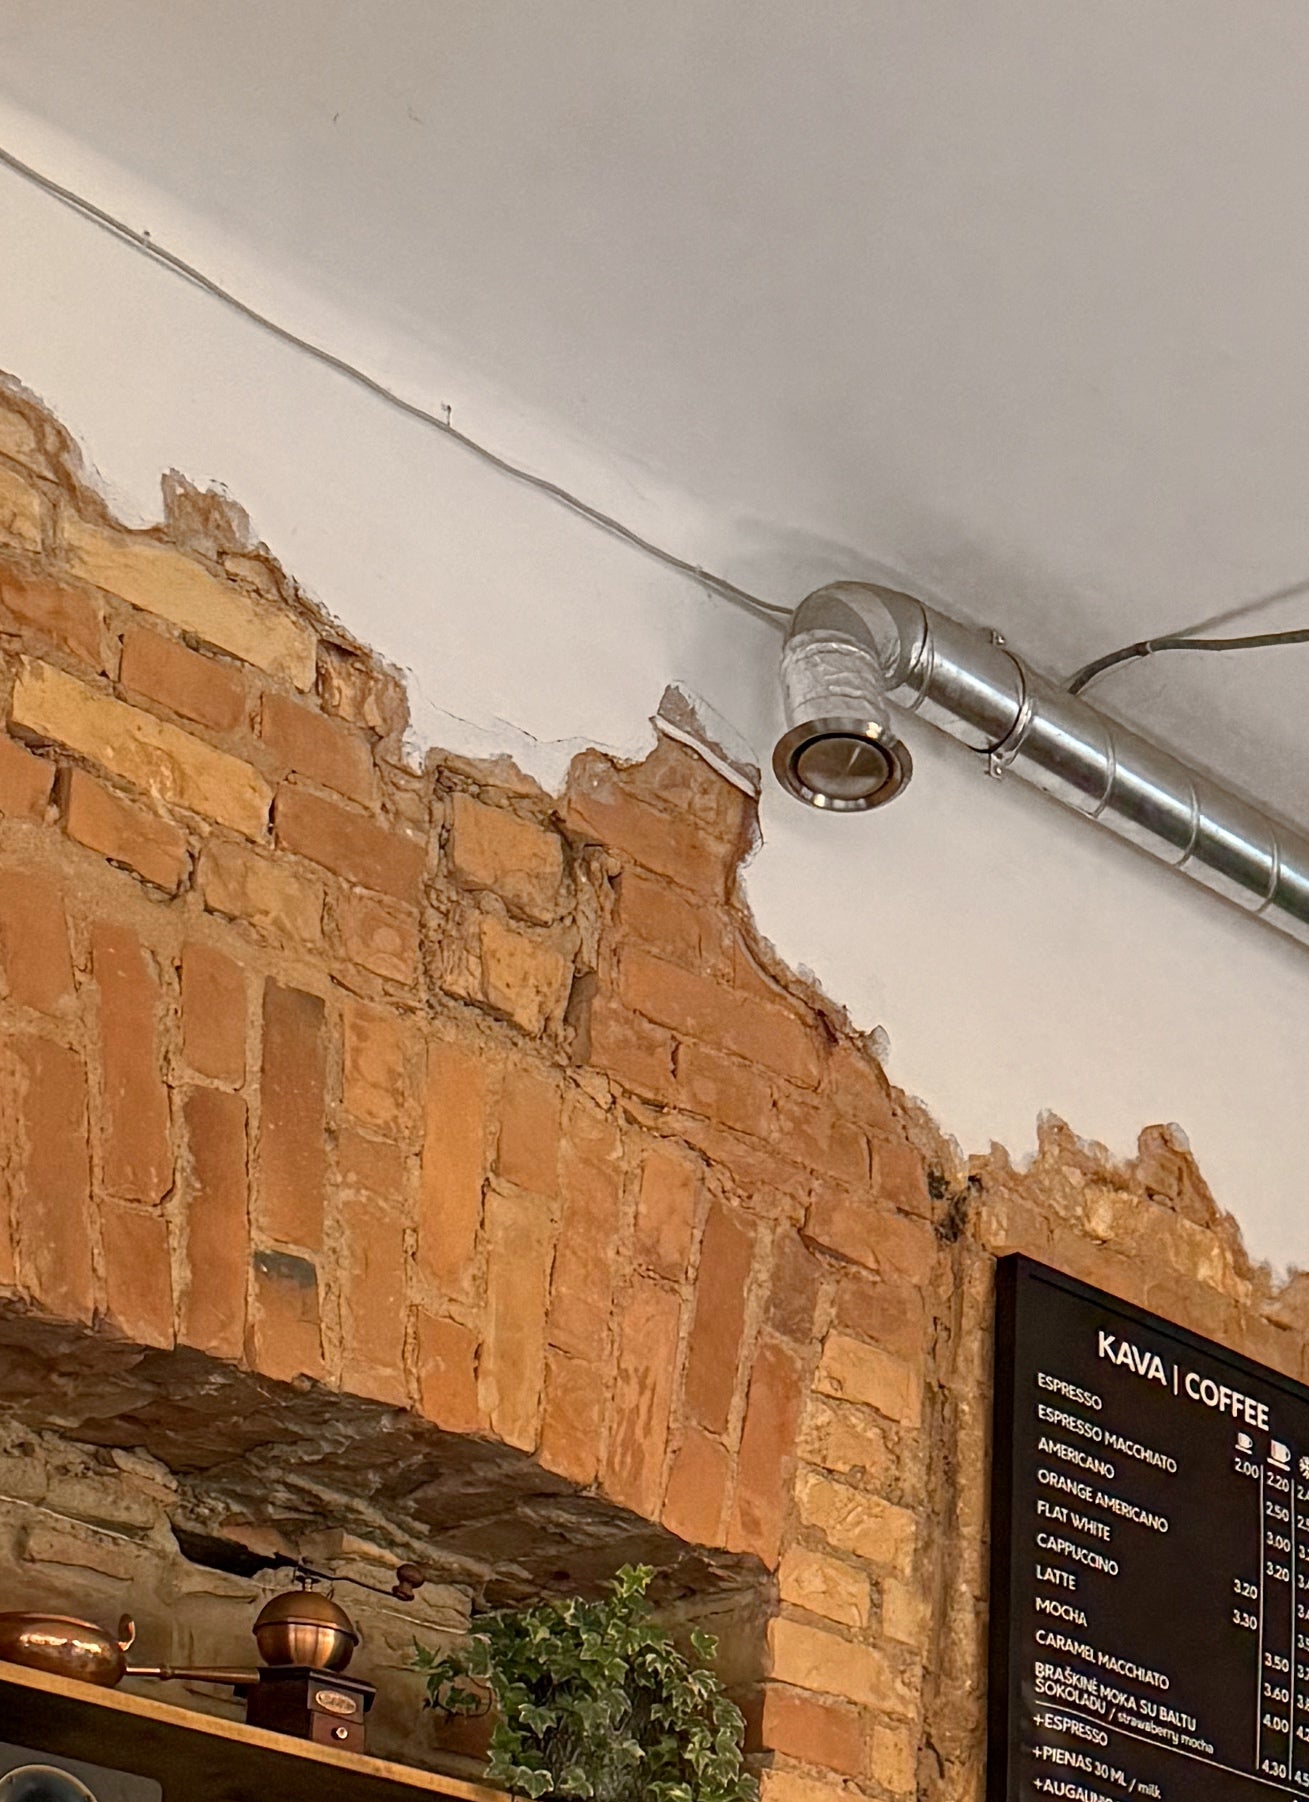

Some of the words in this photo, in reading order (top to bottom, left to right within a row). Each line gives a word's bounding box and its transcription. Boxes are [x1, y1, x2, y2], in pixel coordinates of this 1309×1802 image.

[1099, 1331, 1167, 1385] KAVA
[1185, 1373, 1269, 1431] COFFEE
[1038, 1372, 1102, 1410] ESPRESSO
[1235, 1457, 1259, 1478] 2.00
[1267, 1472, 1289, 1492] 2.20
[1038, 1404, 1102, 1441] ESPRESSO
[1105, 1431, 1177, 1473] MACCHIATO
[1266, 1501, 1289, 1522] 2.50
[1037, 1500, 1068, 1523] FLAT
[1070, 1512, 1110, 1541] WHITE
[1038, 1437, 1114, 1478] AMERICANO
[1267, 1531, 1291, 1552] 3.00
[1038, 1469, 1093, 1502] ORANGE
[1095, 1492, 1168, 1532] AMERICANO
[1266, 1561, 1289, 1582] 3.20
[1037, 1533, 1118, 1575] CAPPUCCINO
[1234, 1579, 1258, 1599] 3.20
[1036, 1597, 1087, 1627] MOCHA
[1264, 1683, 1289, 1703] 3.60
[1037, 1565, 1076, 1590] LATTE
[1233, 1609, 1257, 1630] 3.30
[1265, 1652, 1289, 1672] 3.50
[1033, 1713, 1108, 1746] +ESPRESSO
[1036, 1630, 1096, 1663] CARAMEL
[1098, 1652, 1169, 1689] MACCHIATO
[1263, 1714, 1289, 1733] 4.00
[1100, 1684, 1137, 1711] MOKA
[1140, 1700, 1157, 1717] SU
[1159, 1706, 1196, 1731] BALTU
[1032, 1746, 1092, 1772] +PIENAS
[1094, 1761, 1109, 1779] 30
[1262, 1759, 1286, 1778] 4.30
